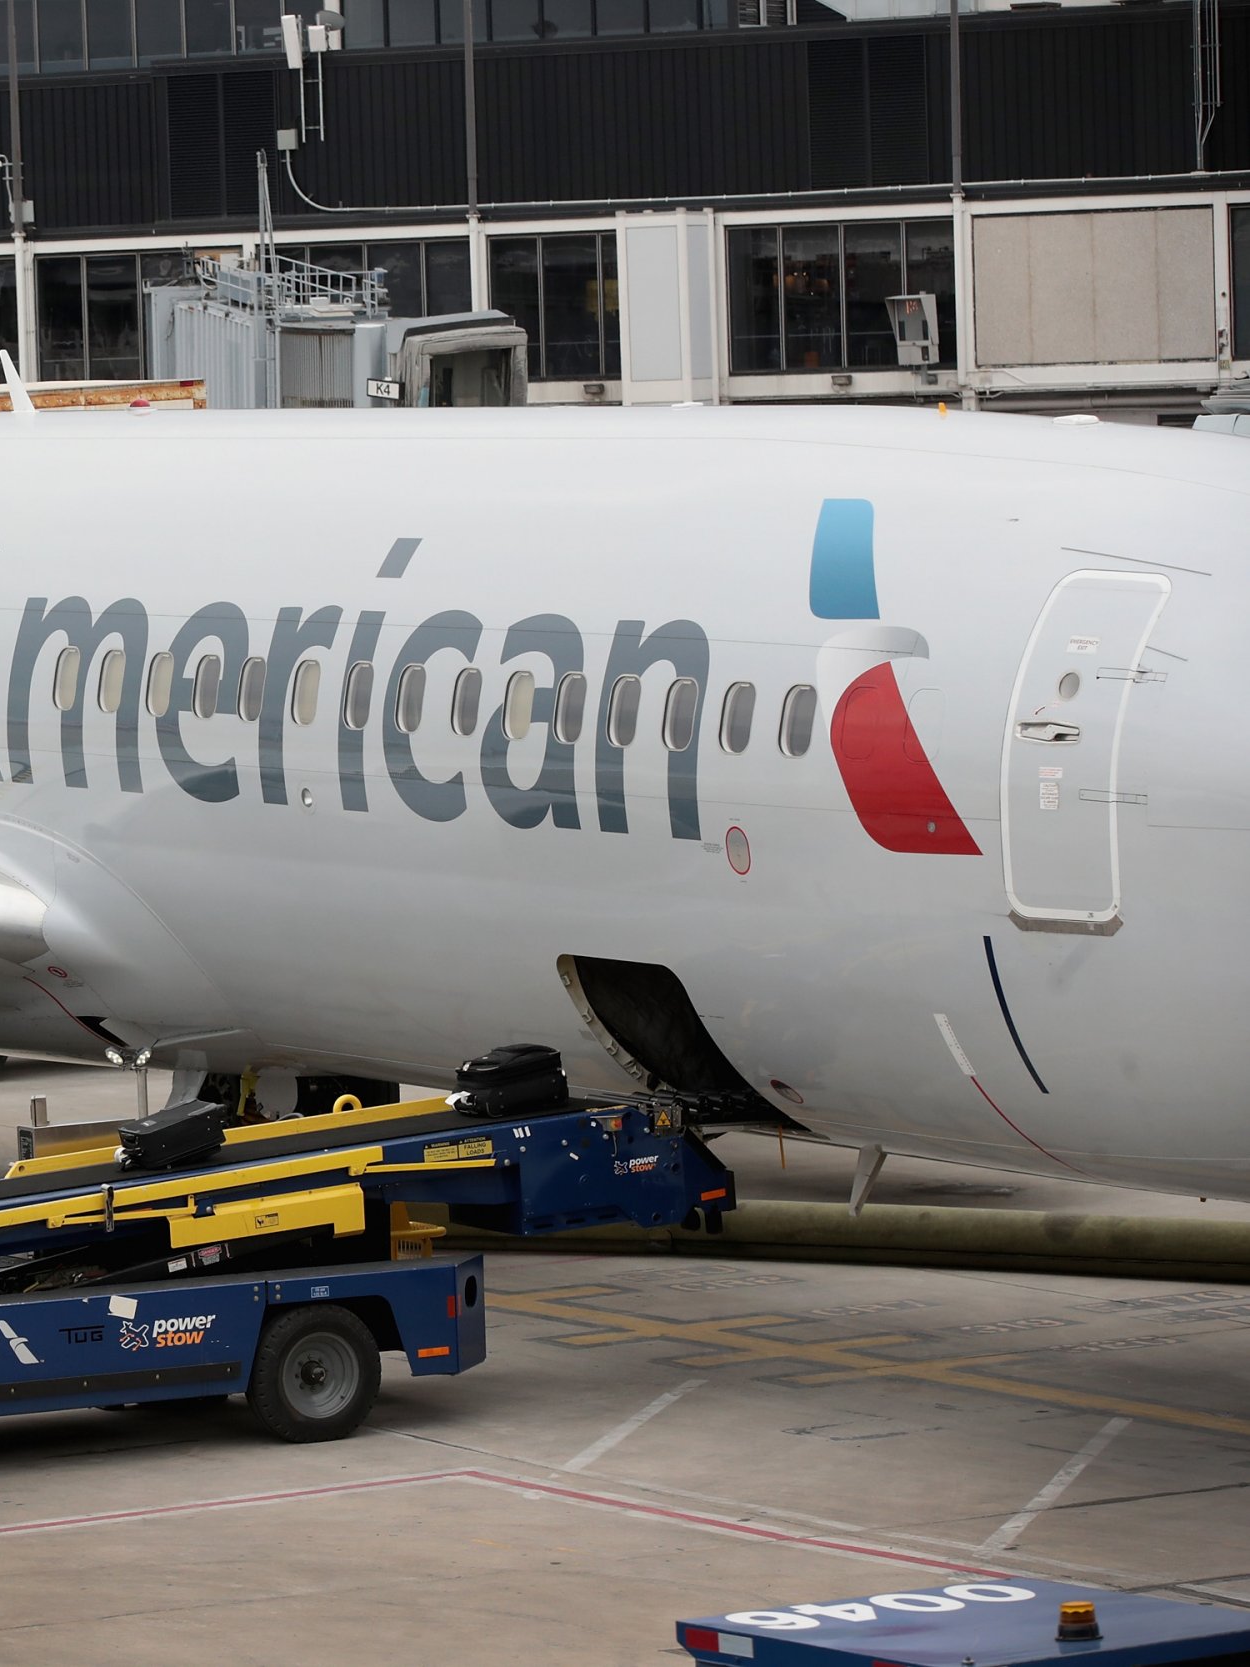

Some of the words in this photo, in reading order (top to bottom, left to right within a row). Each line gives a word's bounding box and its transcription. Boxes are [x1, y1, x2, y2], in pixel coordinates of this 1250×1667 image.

[375, 382, 391, 397] K4
[463, 1142, 487, 1150] FALLING
[466, 1148, 485, 1156] LOADS
[629, 1155, 659, 1169] power
[631, 1163, 654, 1173] stow
[152, 1314, 215, 1338] power
[960, 1318, 1066, 1335] 319
[58, 1325, 105, 1344] TUG
[155, 1330, 204, 1348] stow
[724, 1584, 1037, 1631] 0046
